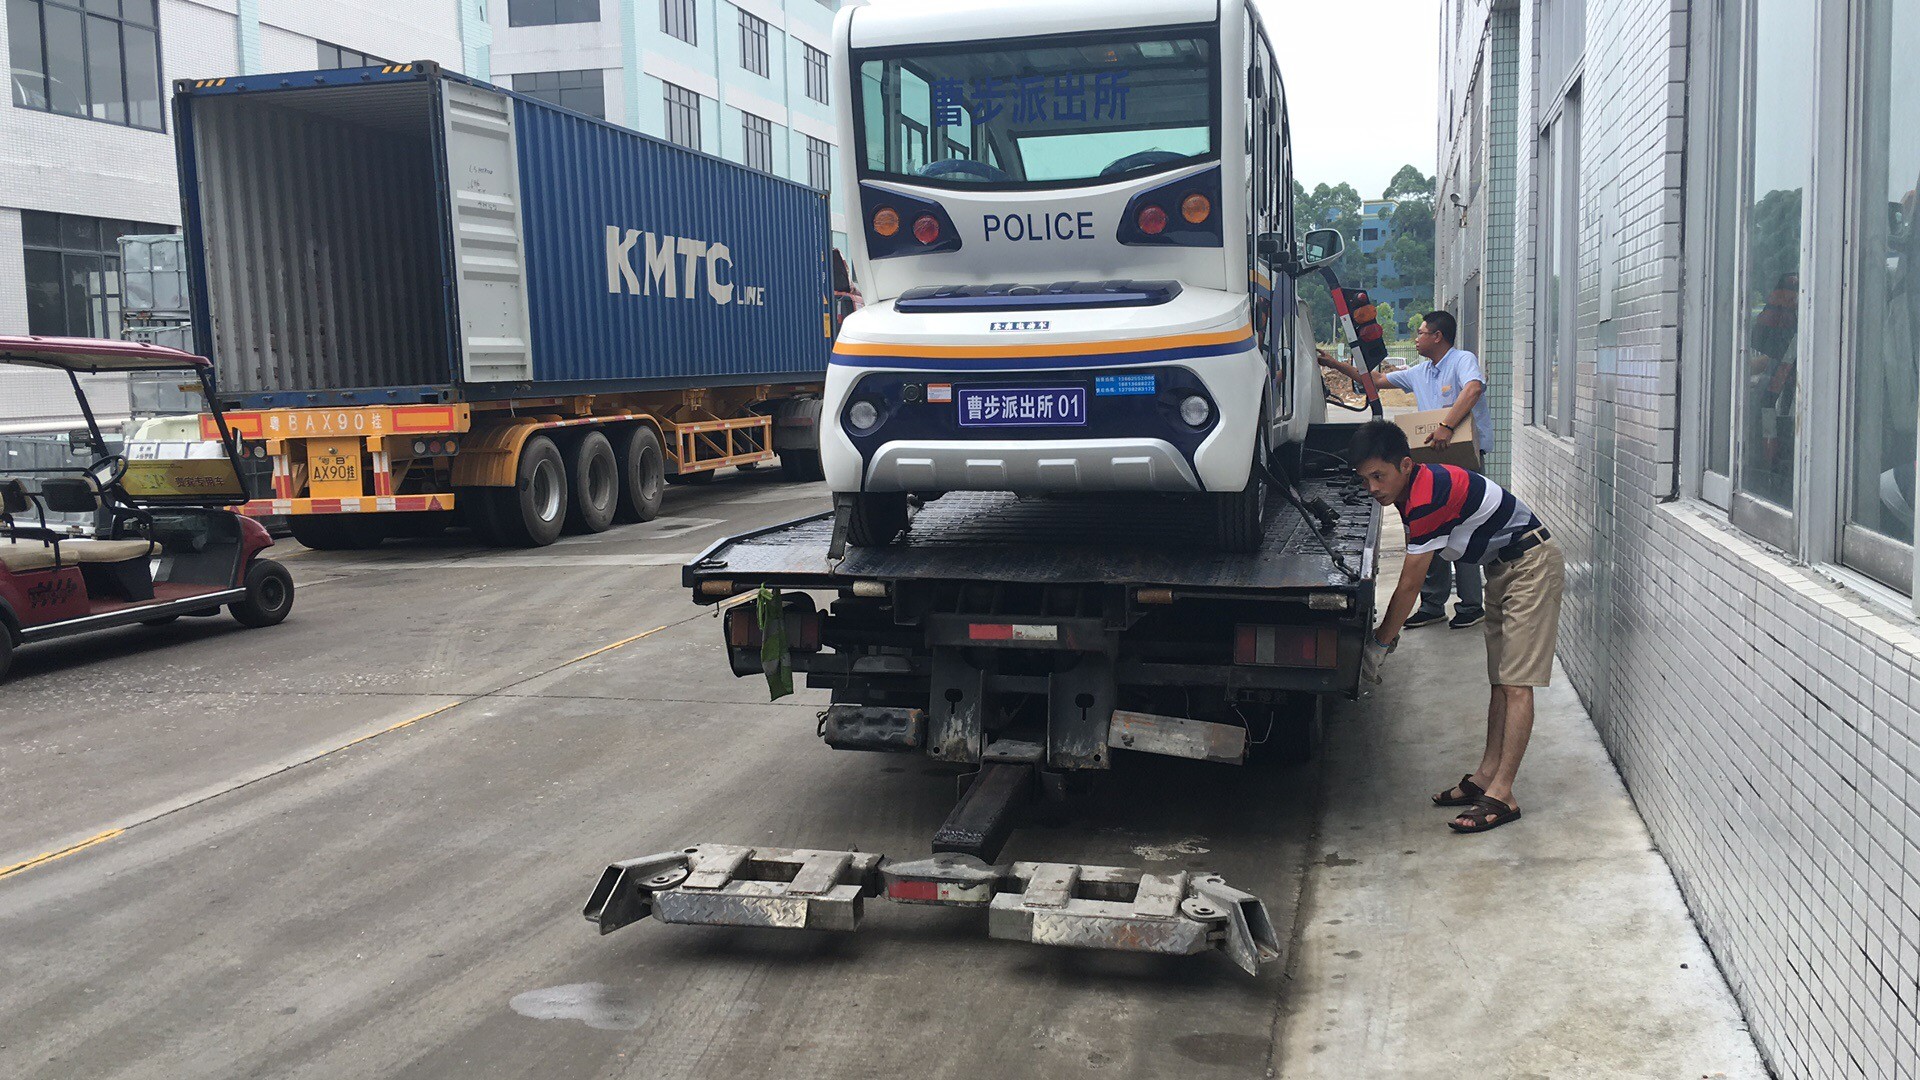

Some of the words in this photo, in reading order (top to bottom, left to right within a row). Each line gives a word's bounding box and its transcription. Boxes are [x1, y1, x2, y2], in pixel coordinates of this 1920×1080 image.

[935, 71, 1130, 126] 曹步派出所
[984, 212, 1094, 241] POLICE
[606, 225, 734, 305] KMTC
[736, 285, 765, 306] LINE
[967, 395, 1054, 421] 曹步派出所
[1058, 395, 1079, 418] 01
